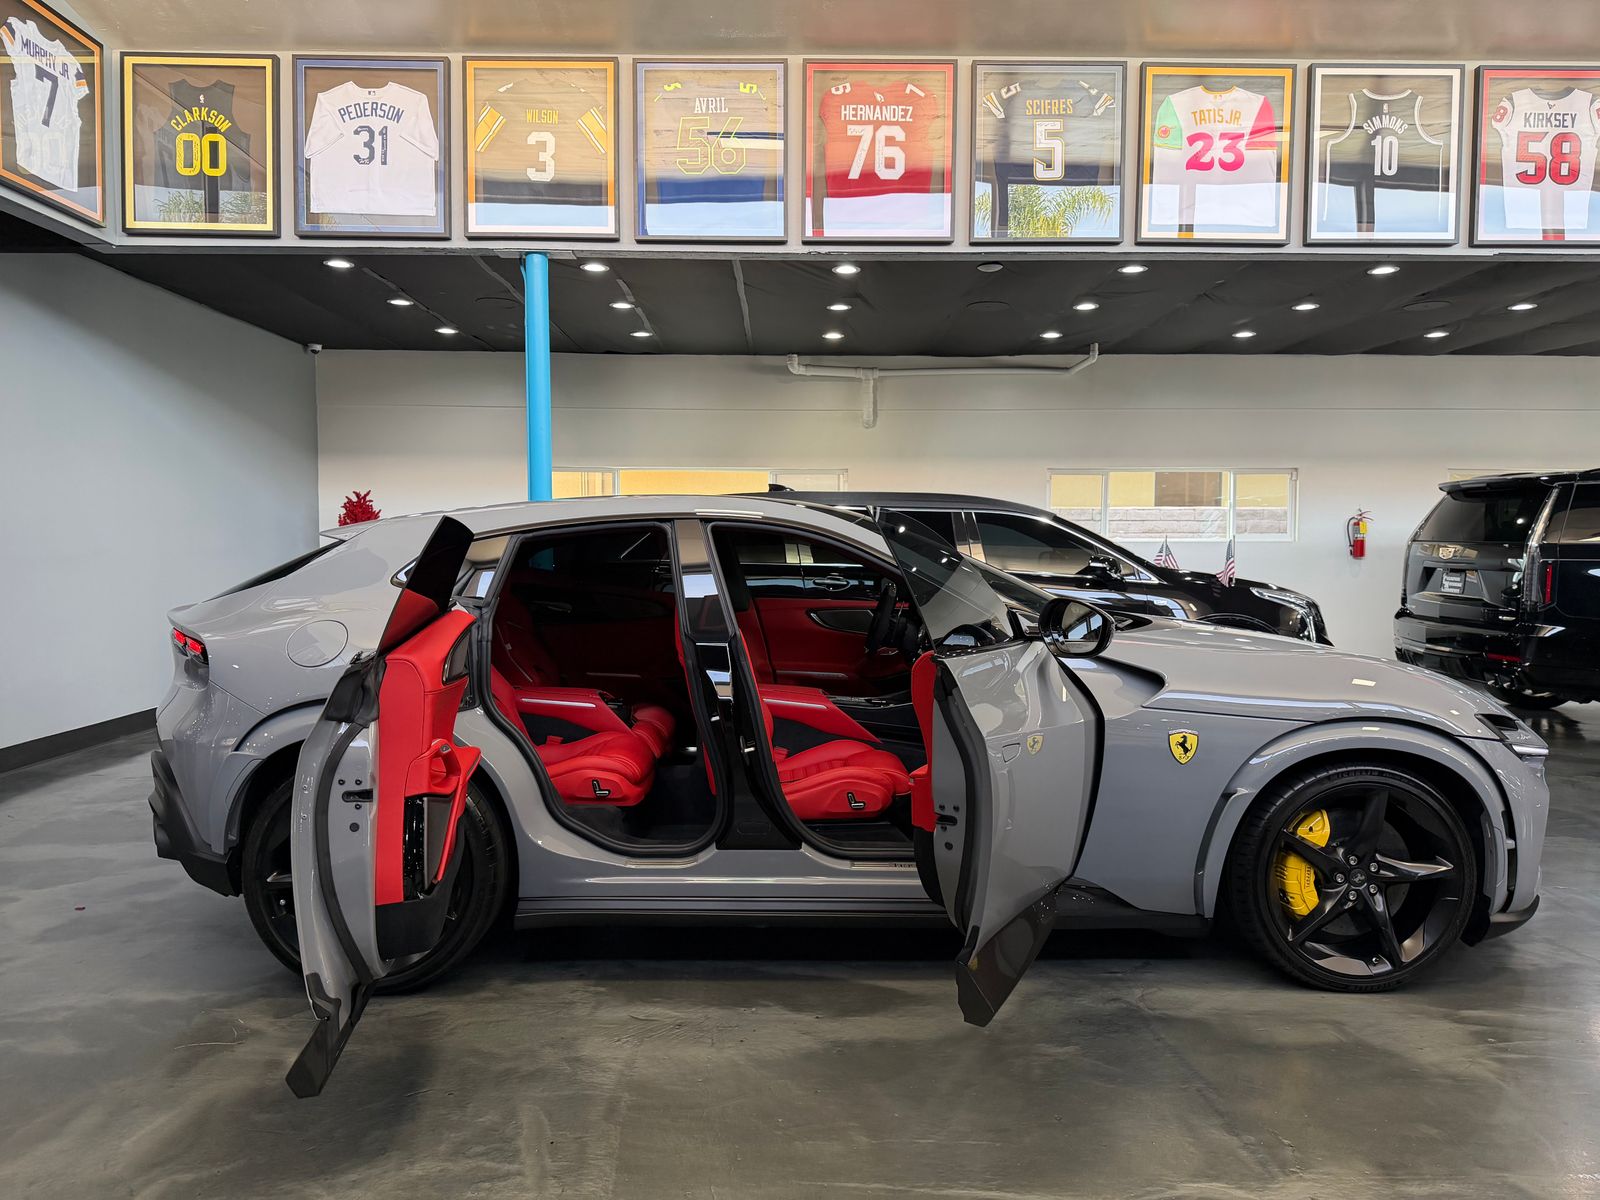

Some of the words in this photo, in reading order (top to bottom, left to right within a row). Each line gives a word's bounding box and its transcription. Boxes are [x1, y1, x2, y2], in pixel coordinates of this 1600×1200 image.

[20, 34, 57, 72] MURPHY
[59, 62, 70, 81] JR
[34, 64, 59, 129] 7
[338, 101, 405, 124] PEDERSON
[526, 109, 559, 125] WILSON
[694, 97, 729, 114] AVRIL
[841, 104, 913, 122] HERNANDEZ
[1025, 98, 1073, 116] SCIFRES
[170, 107, 232, 132] CLARKSON
[1191, 108, 1225, 127] TATIS
[1362, 114, 1409, 135] SIMMONS
[1523, 112, 1578, 128] KIRKSEY
[176, 132, 227, 177] 00
[353, 125, 388, 166] 31
[526, 131, 556, 182] 3
[676, 116, 746, 175] 56
[846, 124, 906, 180] 76
[1033, 118, 1065, 181] 5
[1185, 131, 1245, 172] 23
[1371, 135, 1399, 176] 10
[1516, 131, 1582, 185] 58
